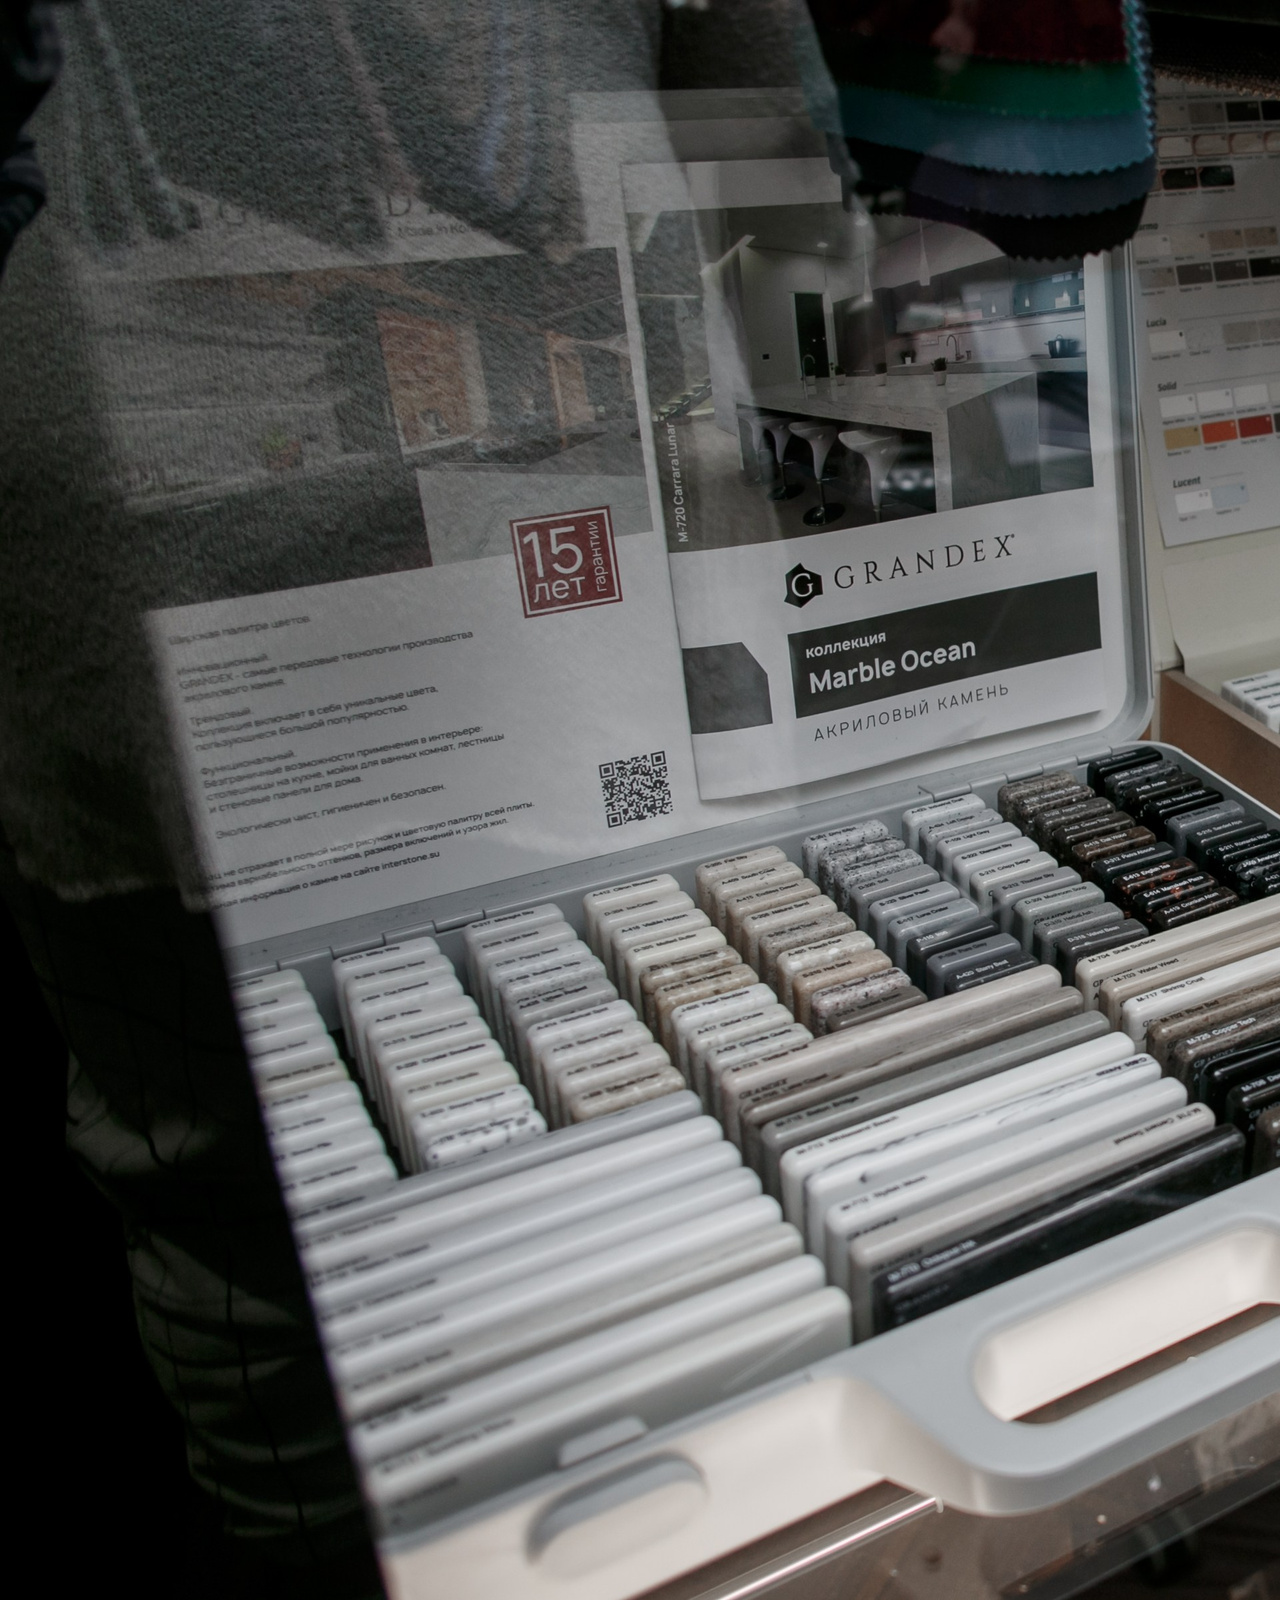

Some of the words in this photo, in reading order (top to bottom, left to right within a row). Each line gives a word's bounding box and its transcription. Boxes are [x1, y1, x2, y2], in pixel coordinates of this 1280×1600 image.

[1146, 317, 1167, 328] Lucia
[1157, 381, 1177, 393] Solid
[666, 422, 679, 457] Lunar
[671, 458, 684, 506] Carrara
[1172, 476, 1202, 488] Lucent
[674, 506, 689, 542] M-720
[523, 526, 583, 578] 15
[587, 521, 609, 592] гарантии
[534, 576, 585, 603] лет
[342, 644, 400, 660] технологии
[402, 631, 473, 651] производства
[805, 631, 886, 659] коллекция
[809, 657, 896, 694] Marble
[900, 639, 976, 674] Ocean
[254, 710, 306, 727] включает
[308, 708, 315, 717] в
[317, 702, 342, 715] себя
[343, 691, 404, 710] уникальные
[406, 685, 439, 699] цвета,
[279, 719, 325, 735] большой
[326, 703, 409, 728] популярностью.
[813, 699, 930, 742] АКРИЛОВЫЙ
[937, 685, 1009, 710] КАМЕНЬ
[203, 765, 282, 790] Безграничные
[284, 751, 355, 772] возможности
[357, 738, 419, 759] применения
[421, 736, 426, 744] в
[428, 725, 484, 745] интерьере:
[277, 777, 290, 786] на
[326, 762, 359, 776] мойки
[360, 759, 379, 771] для
[381, 751, 417, 764] ванных
[419, 743, 456, 759] комнат,
[457, 733, 505, 751] лестницы
[273, 786, 311, 800] панели
[313, 781, 333, 793] для
[216, 815, 292, 839] Экологически
[294, 810, 320, 824] чист,
[322, 797, 381, 816] гигиеничен
[383, 795, 389, 803] и
[391, 782, 447, 801] безопасен.
[237, 857, 284, 875] отражает
[286, 855, 292, 863] в
[402, 820, 447, 838] цветовую
[447, 812, 483, 827] палитру
[484, 805, 505, 818] всей
[506, 800, 535, 812] плиты.
[364, 841, 403, 857] размера
[404, 828, 454, 847] включений
[462, 822, 488, 835] узора
[489, 817, 509, 827] жил.
[962, 831, 978, 840] Light
[979, 828, 990, 836] Grey
[302, 881, 309, 889] о
[310, 874, 338, 887] камне
[340, 871, 352, 880] на
[353, 863, 380, 876] сайте
[381, 850, 440, 870] interstone.su
[1141, 866, 1158, 877] English
[1159, 862, 1170, 870] Tea
[1043, 889, 1071, 899] Mushroom
[1072, 884, 1087, 894] Soup
[1087, 951, 1110, 963] M-704
[1112, 945, 1130, 955] Shell
[1130, 936, 1156, 949] Surface
[1113, 970, 1136, 983] M-703
[1139, 963, 1158, 975] Water
[1159, 956, 1179, 968] Weed
[1136, 990, 1158, 1003] M-717
[1161, 982, 1185, 995] Shrimp
[1186, 975, 1205, 986] Crust
[1211, 1022, 1238, 1038] Copper
[1238, 1014, 1257, 1027] Tech
